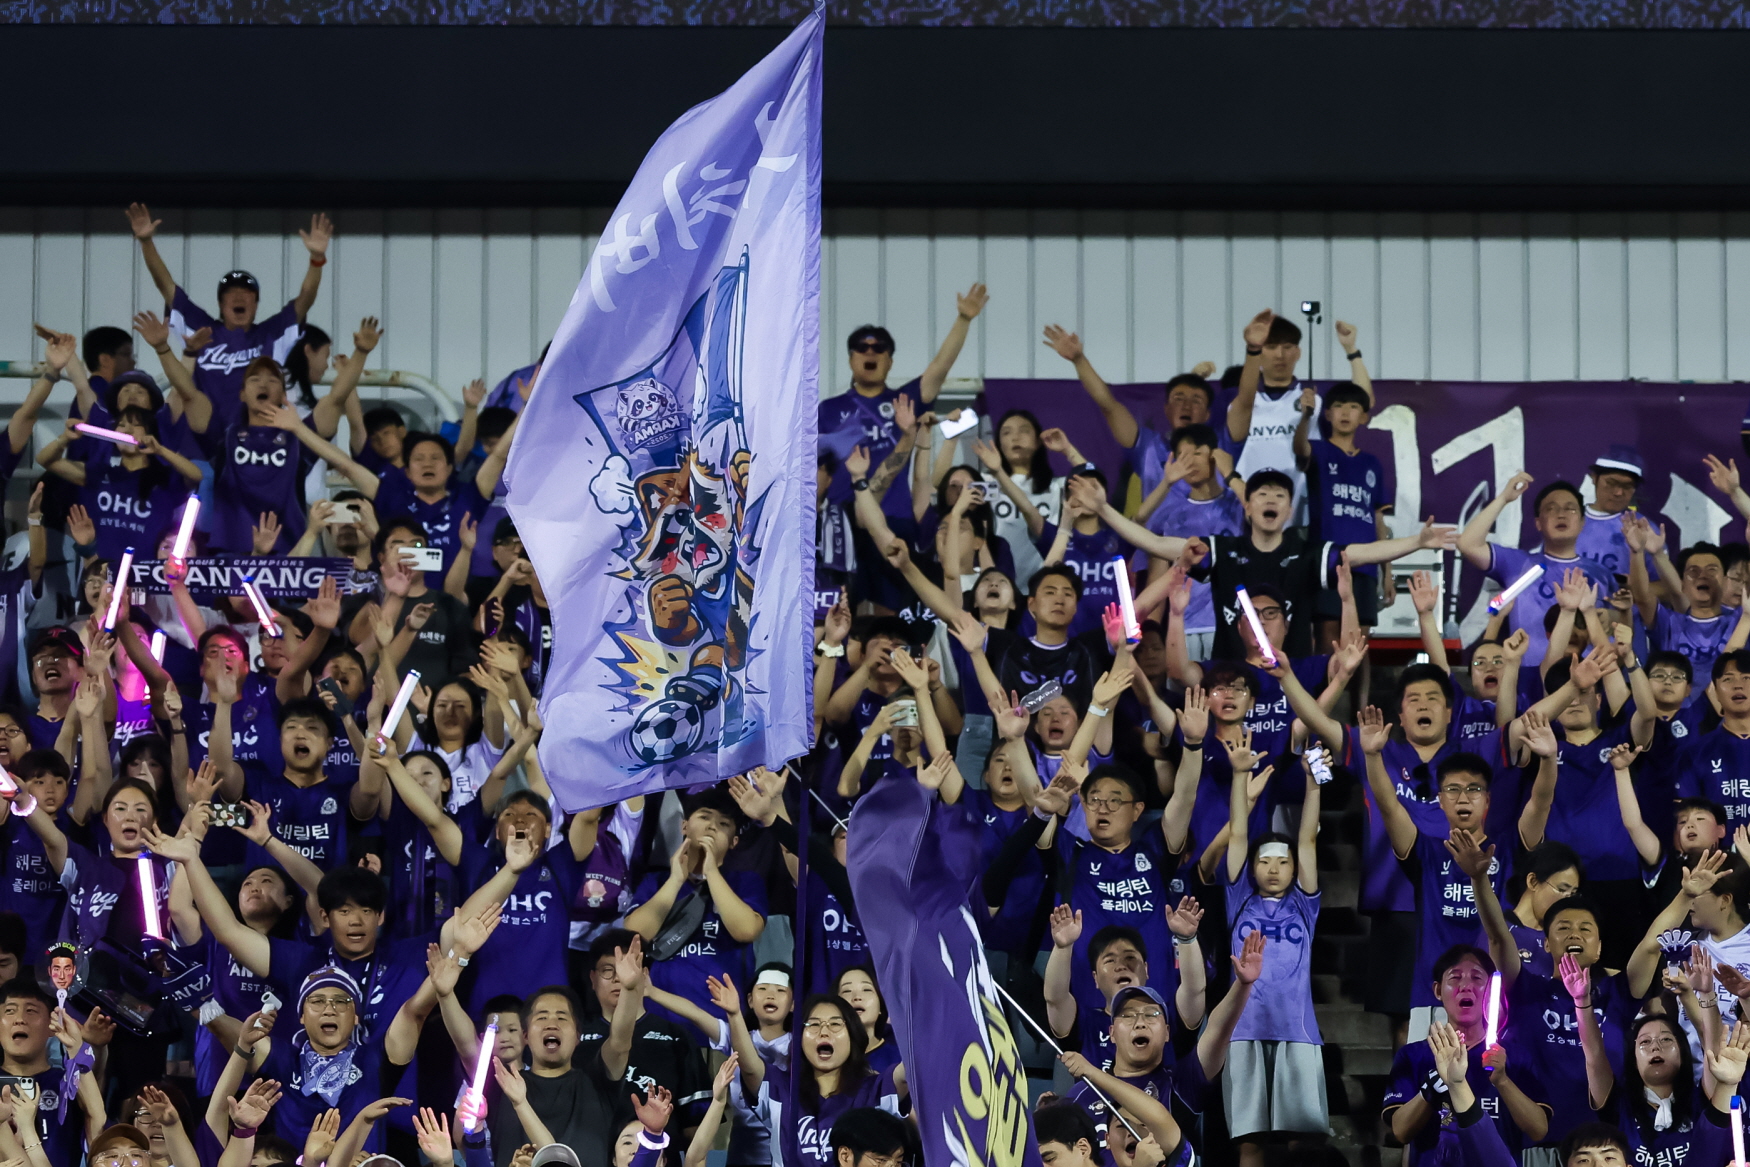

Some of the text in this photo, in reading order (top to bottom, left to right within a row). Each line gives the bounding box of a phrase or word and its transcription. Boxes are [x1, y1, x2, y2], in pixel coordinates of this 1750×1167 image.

[234, 447, 287, 467] OHC
[98, 491, 152, 518] OHC
[235, 558, 306, 567] CHAMPIONS
[190, 568, 327, 589] ANYANG
[1097, 881, 1151, 899] 해링턴
[1444, 884, 1486, 901] 해링
[501, 892, 551, 913] HC
[1100, 900, 1153, 913] 플레이스
[1238, 921, 1303, 944] OHC
